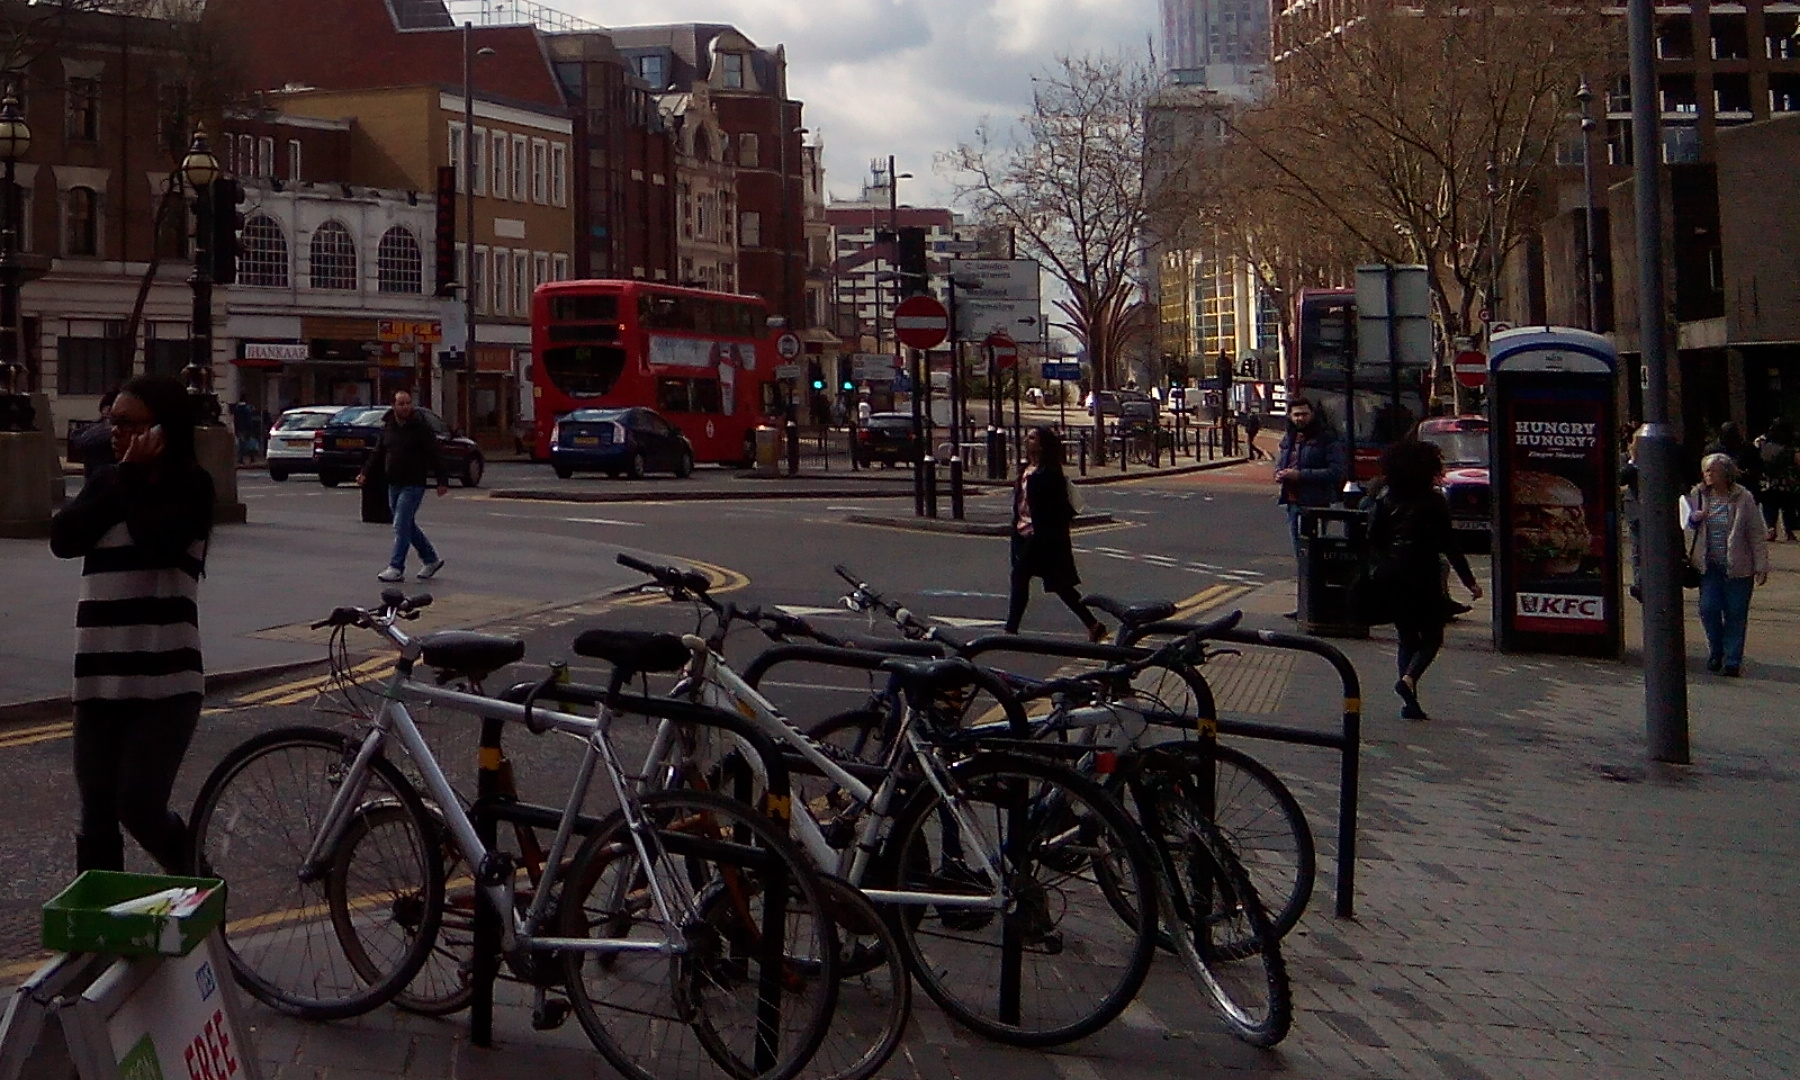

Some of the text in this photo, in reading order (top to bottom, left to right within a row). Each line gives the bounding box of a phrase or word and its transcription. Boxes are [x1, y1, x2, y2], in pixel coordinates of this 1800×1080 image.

[1515, 422, 1596, 434] HUNGRY
[1516, 435, 1596, 447] HUNGRY?
[1540, 597, 1597, 615] KFC
[184, 1009, 237, 1080] FREE
